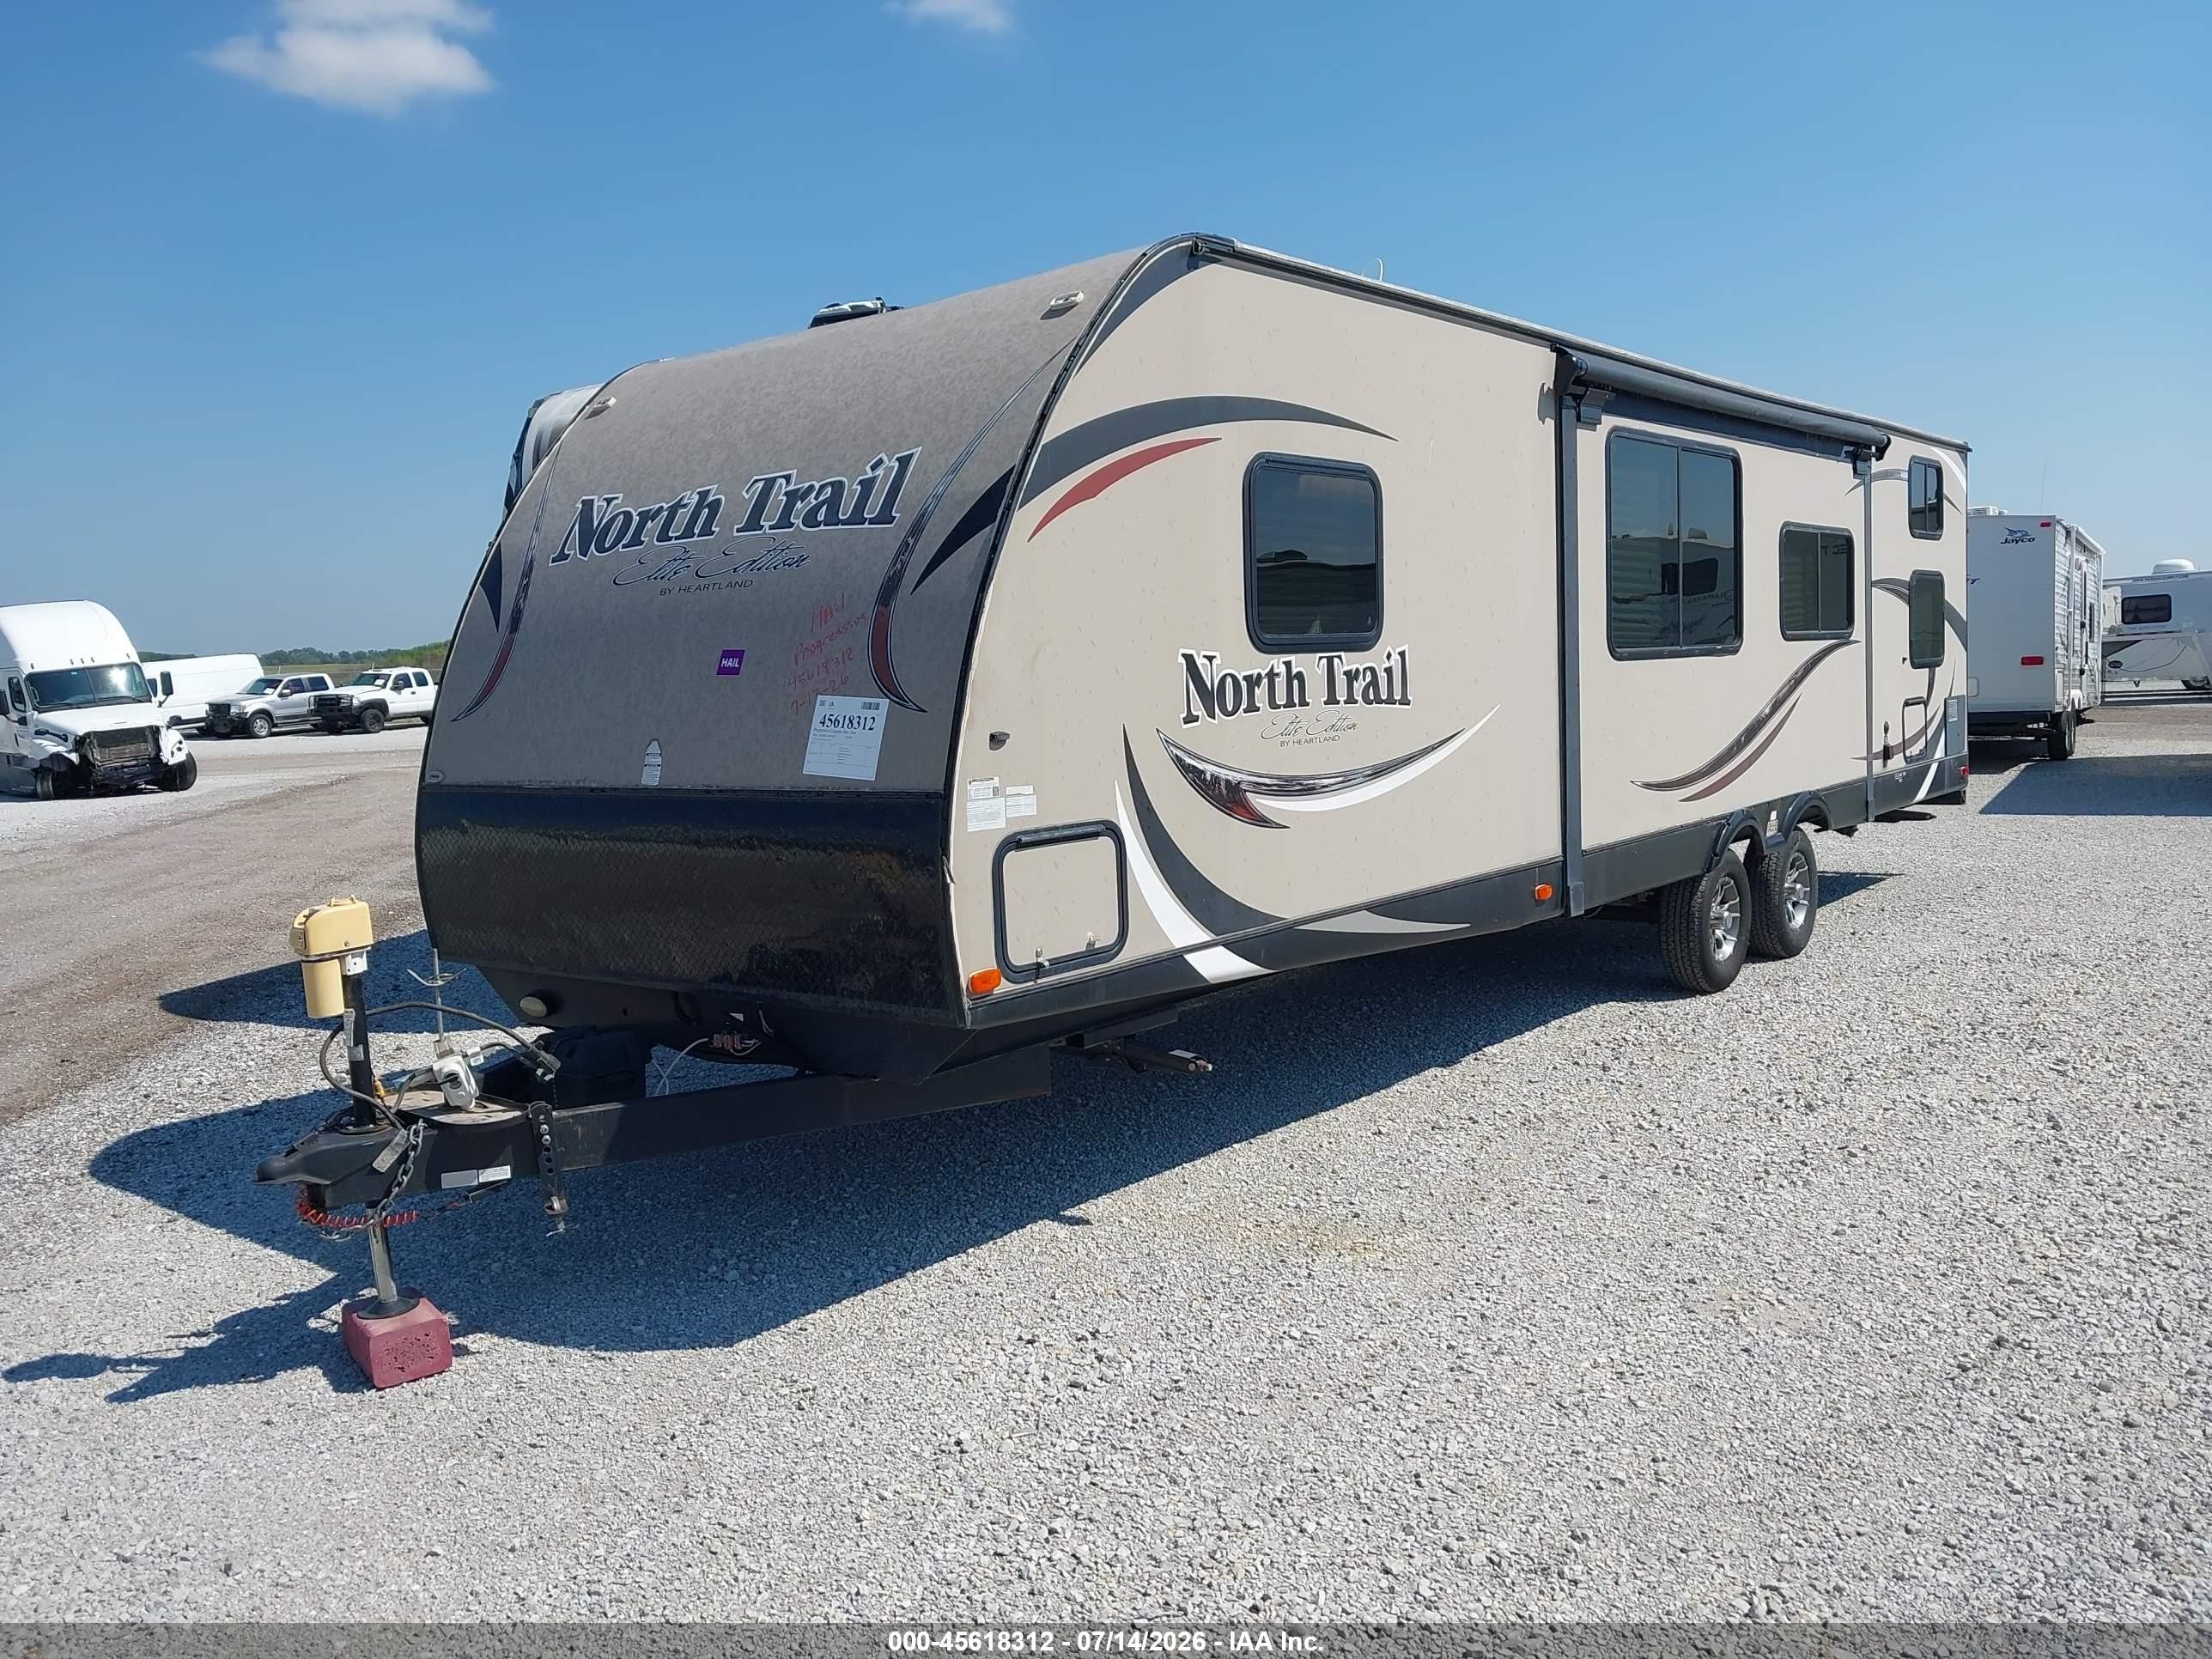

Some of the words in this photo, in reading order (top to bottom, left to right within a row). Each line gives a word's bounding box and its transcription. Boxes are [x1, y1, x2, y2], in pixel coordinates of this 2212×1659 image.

[550, 484, 725, 565] North
[733, 447, 922, 536] Trail
[2000, 537, 2036, 545] Jayco
[611, 545, 704, 586] Elite
[695, 537, 811, 580] Edition
[659, 586, 675, 597] BY
[678, 579, 753, 595] HEARTLAND
[721, 658, 739, 667] HAIL
[1178, 648, 1312, 729] North
[1315, 644, 1413, 708] Trail
[819, 713, 876, 731] 45618312
[1261, 714, 1308, 740] Elite
[1305, 709, 1359, 737] Edition
[1279, 739, 1291, 748] BY
[1292, 734, 1340, 746] HEARTLAND
